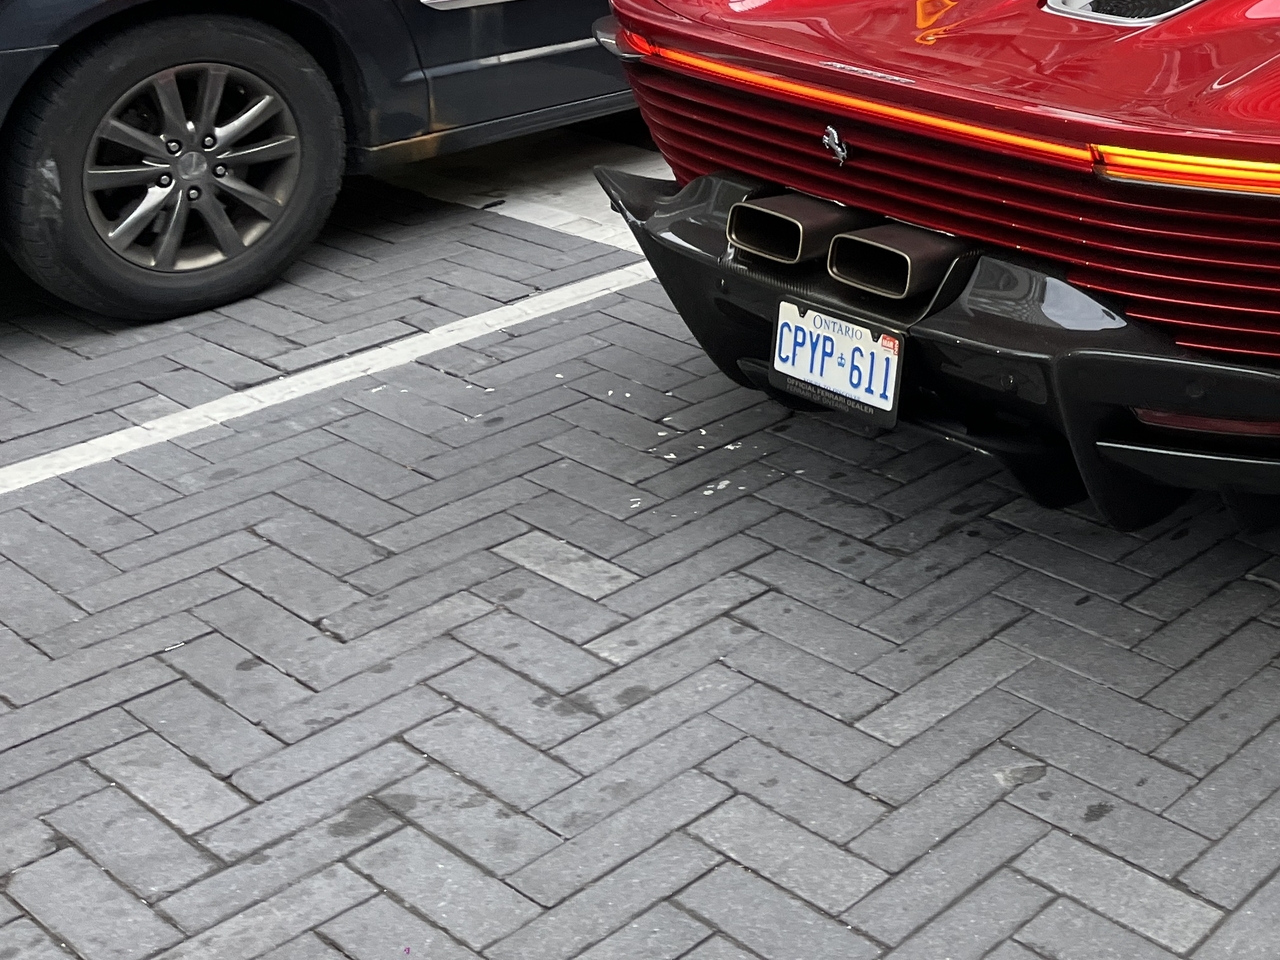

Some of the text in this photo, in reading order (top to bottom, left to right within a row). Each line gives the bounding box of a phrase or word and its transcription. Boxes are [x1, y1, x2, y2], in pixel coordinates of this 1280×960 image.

[813, 314, 863, 341] ONTARIO
[778, 321, 890, 401] CPYP 611
[786, 377, 874, 415] OFFICIAL FERRARI DEALER
[786, 384, 849, 413] FERRARI OF ONTARIO
